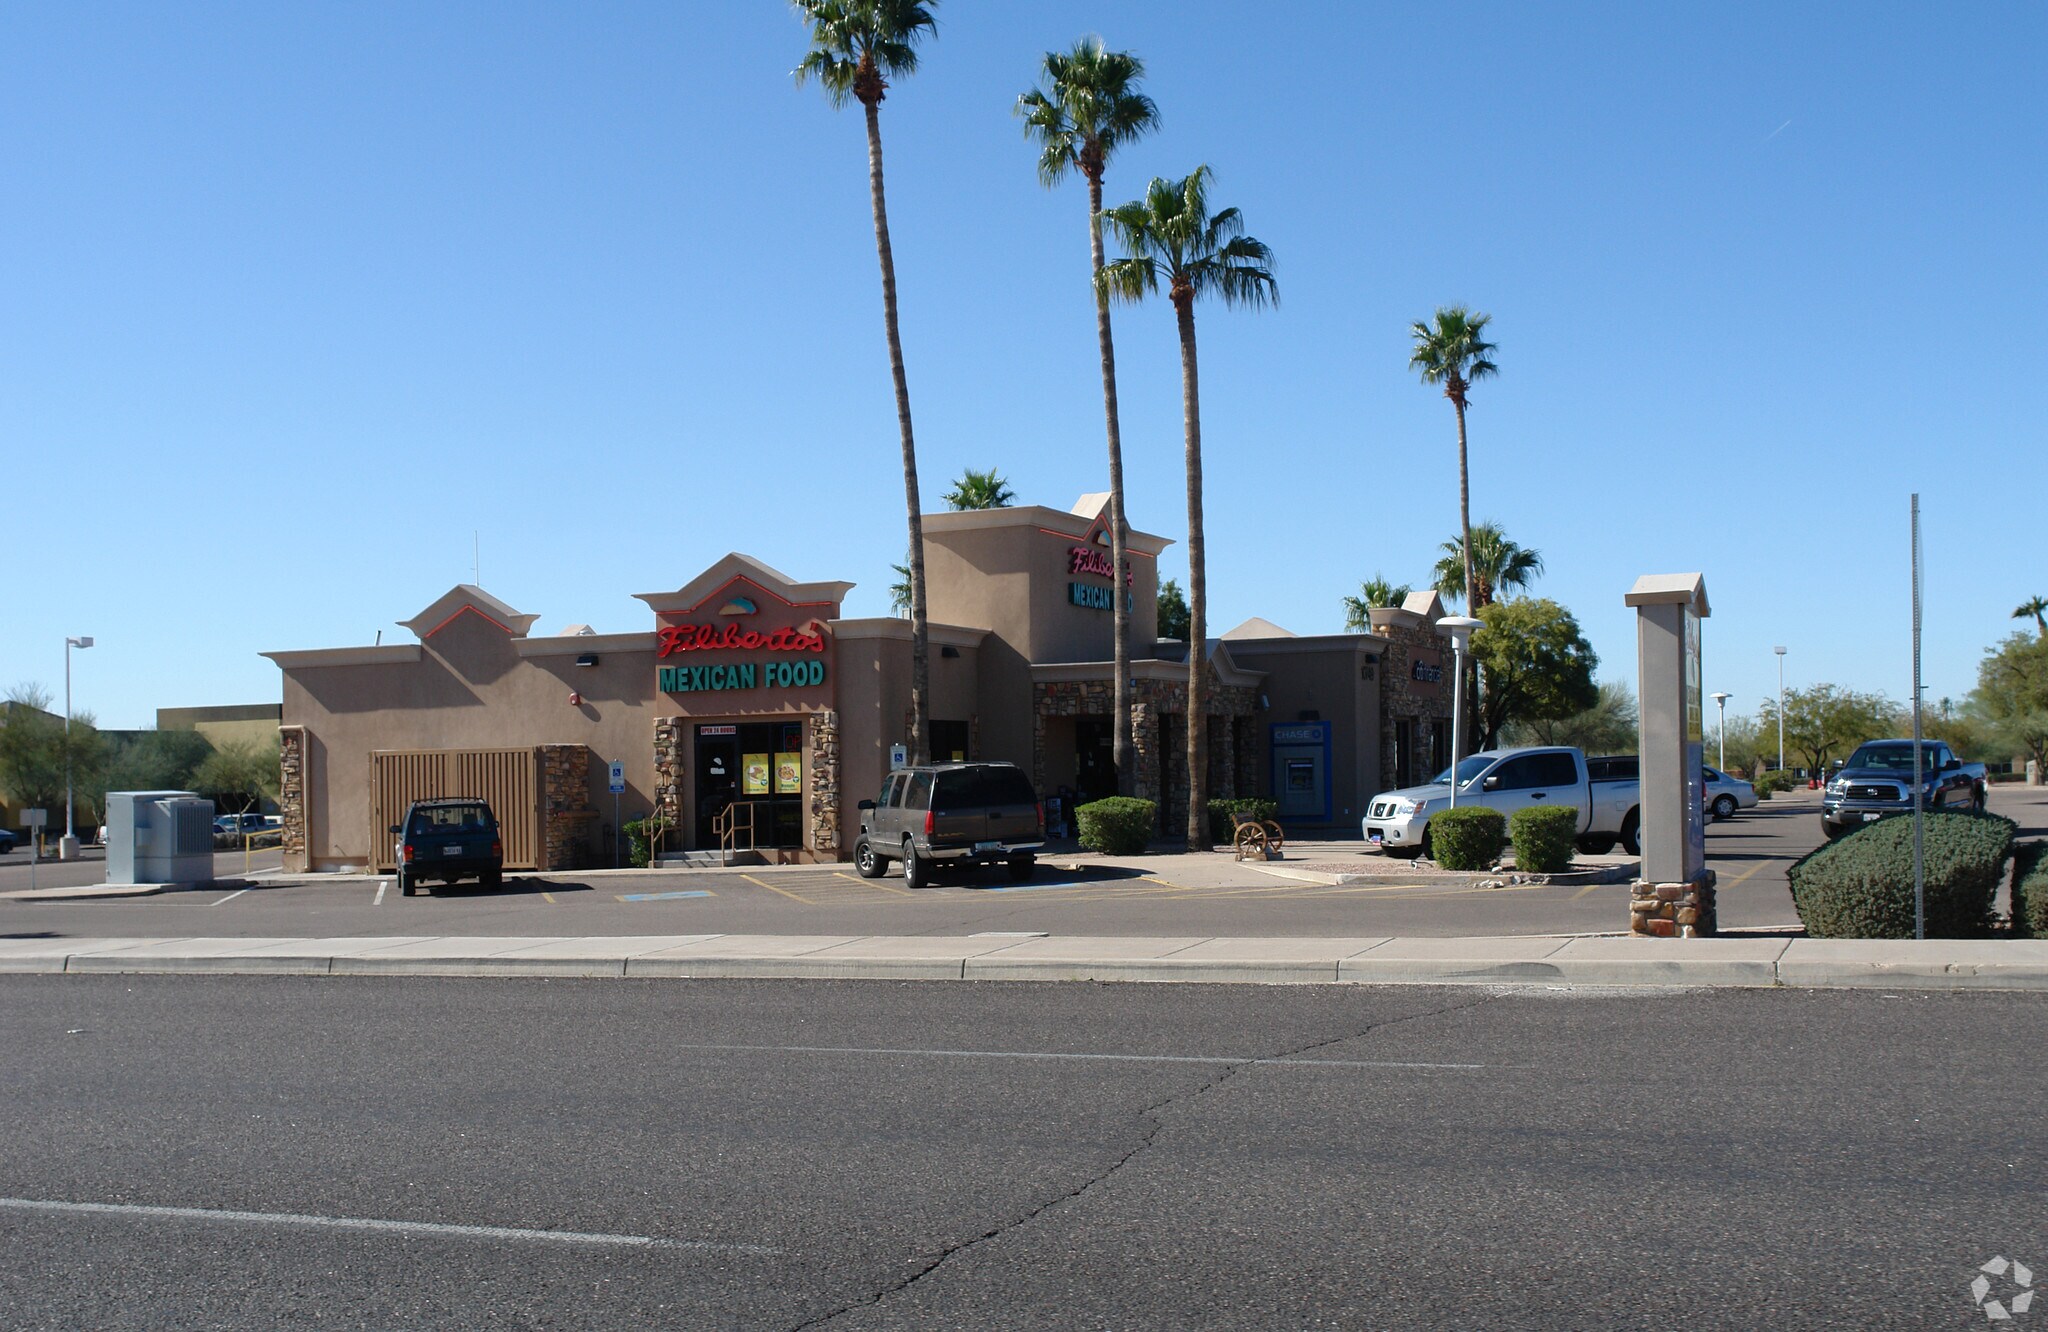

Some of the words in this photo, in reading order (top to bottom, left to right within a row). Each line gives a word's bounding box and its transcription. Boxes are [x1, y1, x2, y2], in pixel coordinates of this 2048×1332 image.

[1072, 546, 1134, 587] Filibe's
[1073, 582, 1110, 610] MEXICAN
[656, 622, 825, 659] Filiberto's
[659, 663, 757, 693] MEXICAN
[764, 660, 824, 688] FOOD
[1274, 730, 1311, 740] CHASE
